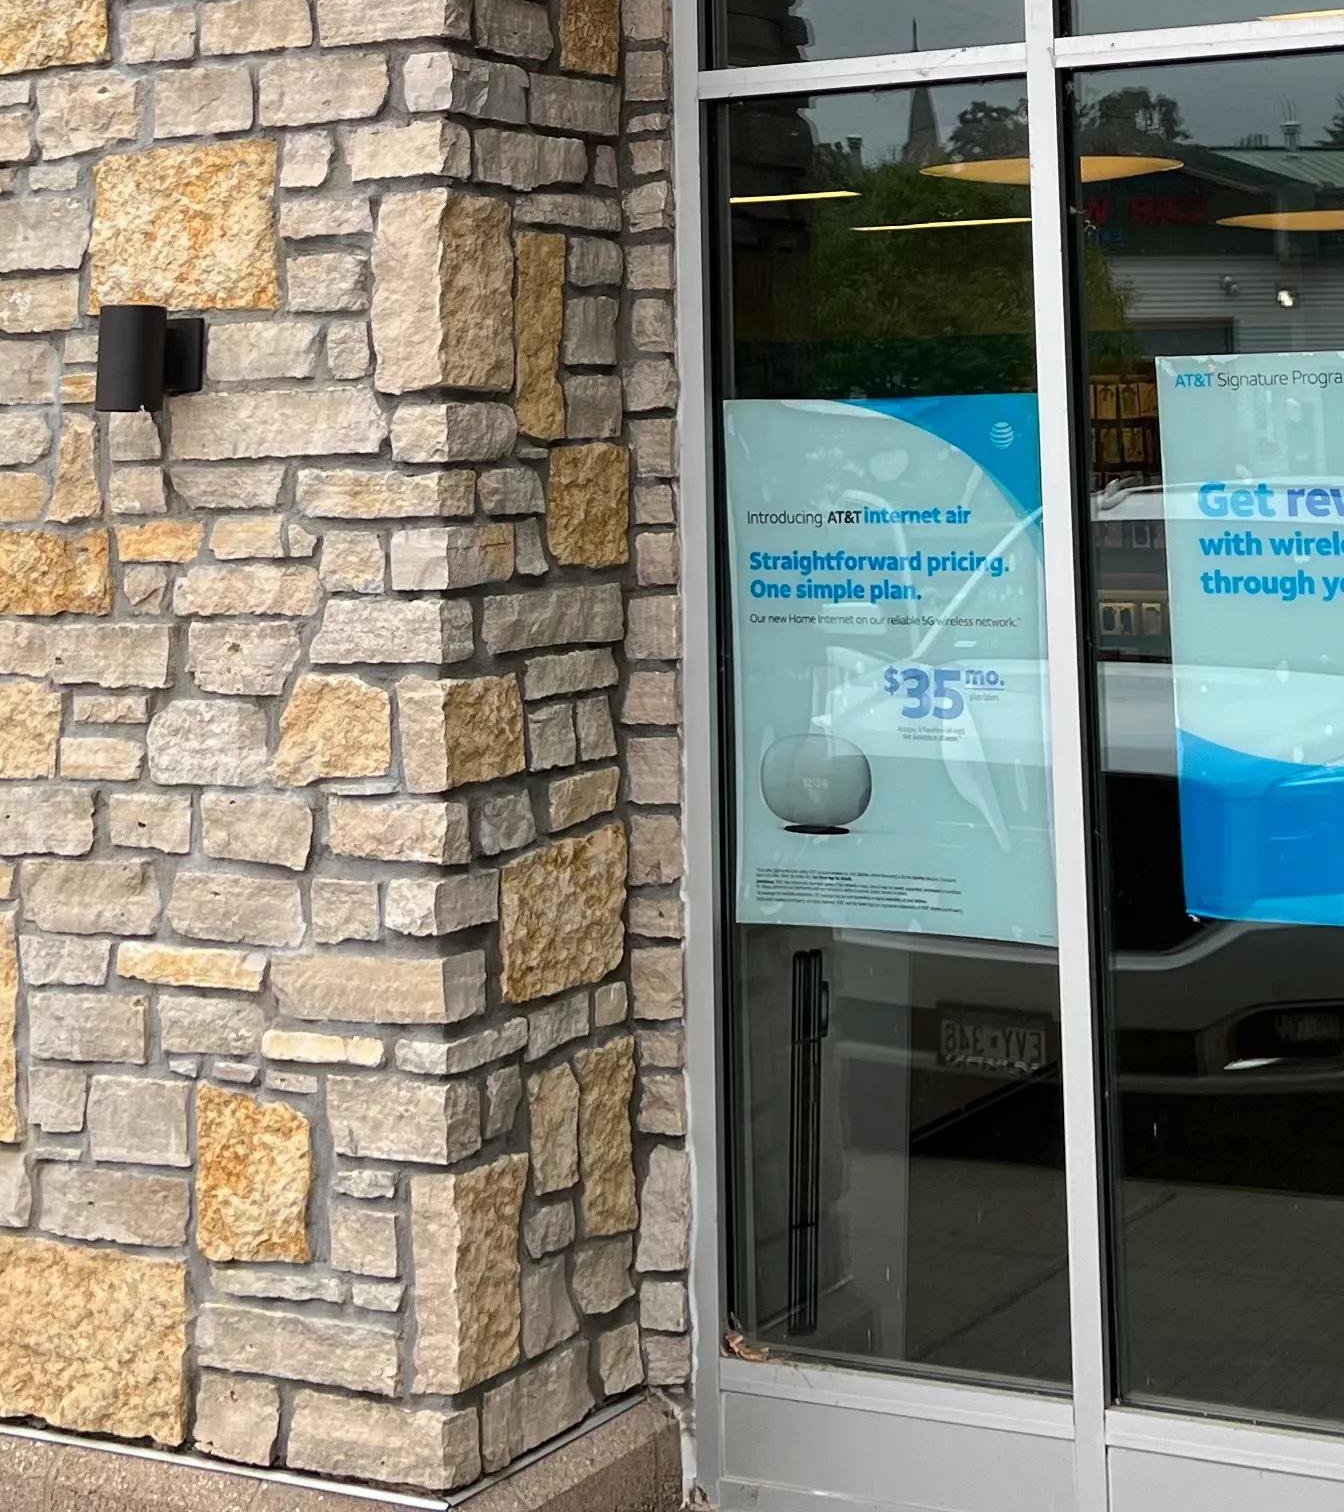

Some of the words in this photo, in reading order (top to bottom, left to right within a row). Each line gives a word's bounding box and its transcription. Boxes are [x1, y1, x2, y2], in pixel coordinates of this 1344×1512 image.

[1174, 373, 1214, 388] AT&T
[1217, 372, 1289, 390] Signature
[1197, 480, 1276, 518] Get
[747, 510, 823, 527] Introducing
[827, 510, 862, 525] AT&T
[863, 506, 941, 524] internet
[946, 505, 972, 524] air
[1198, 531, 1263, 556] with
[749, 550, 922, 576] Straightforward
[927, 551, 1010, 577] pricing.
[750, 579, 792, 599] One
[796, 579, 865, 604] simple
[870, 579, 923, 605] plan.
[1200, 569, 1316, 602] through
[750, 614, 766, 624] Our
[768, 615, 787, 624] new
[789, 614, 816, 625] Home
[818, 614, 854, 625] Internet
[856, 617, 868, 625] on
[870, 617, 885, 625] our
[887, 614, 920, 626] reliable
[921, 616, 935, 626] 5G
[883, 666, 964, 720] $35
[965, 669, 1006, 687] mo.
